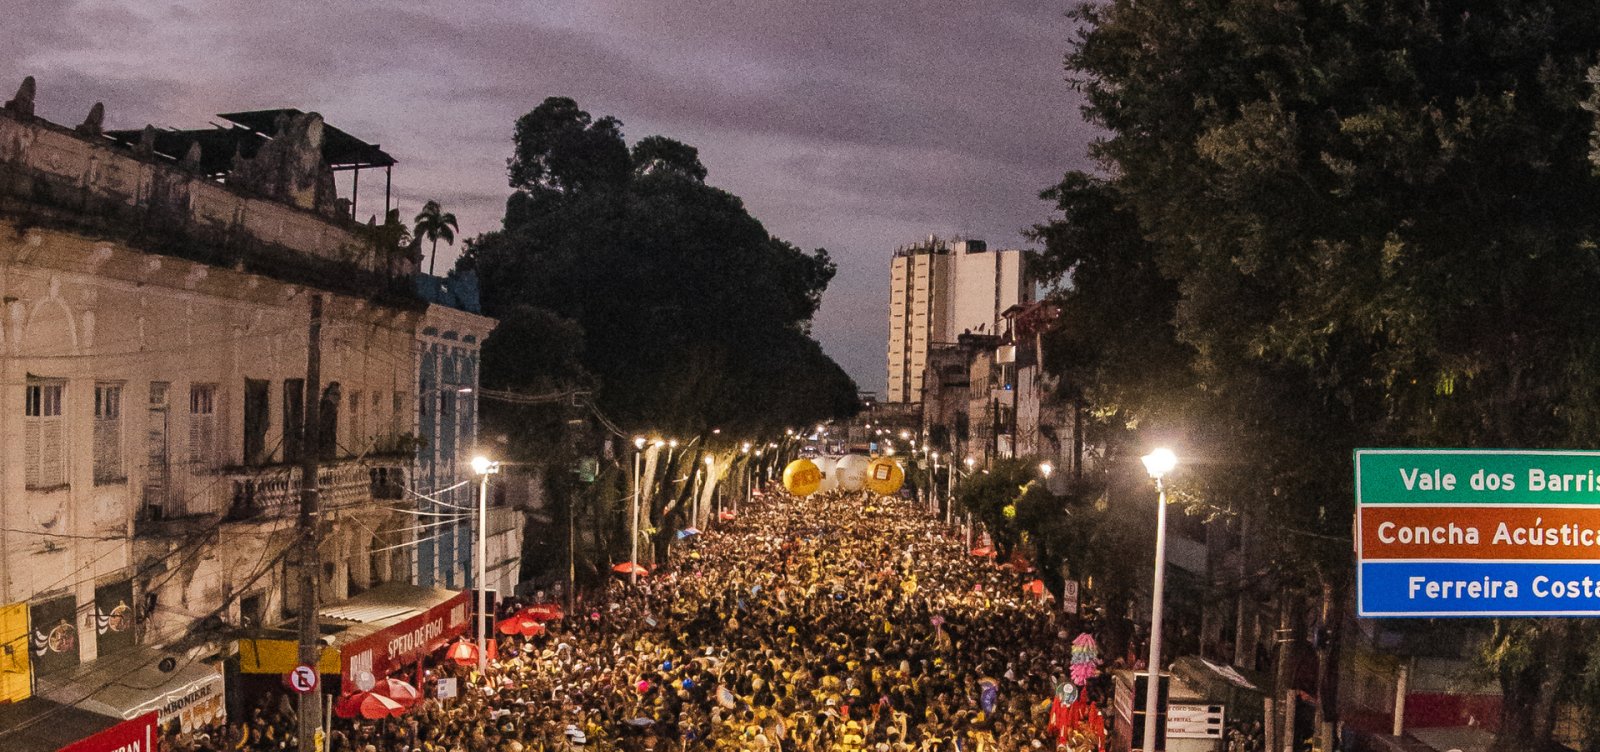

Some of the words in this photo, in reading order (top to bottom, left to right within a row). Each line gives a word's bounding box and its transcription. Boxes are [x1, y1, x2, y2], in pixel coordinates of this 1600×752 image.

[1400, 468, 1457, 491] Vale
[1470, 469, 1516, 491] dos
[1378, 522, 1479, 544] Concha
[1409, 576, 1518, 599] Ferreira
[388, 632, 413, 660] SPETO
[415, 626, 424, 648] DE
[426, 617, 443, 641] FOGO
